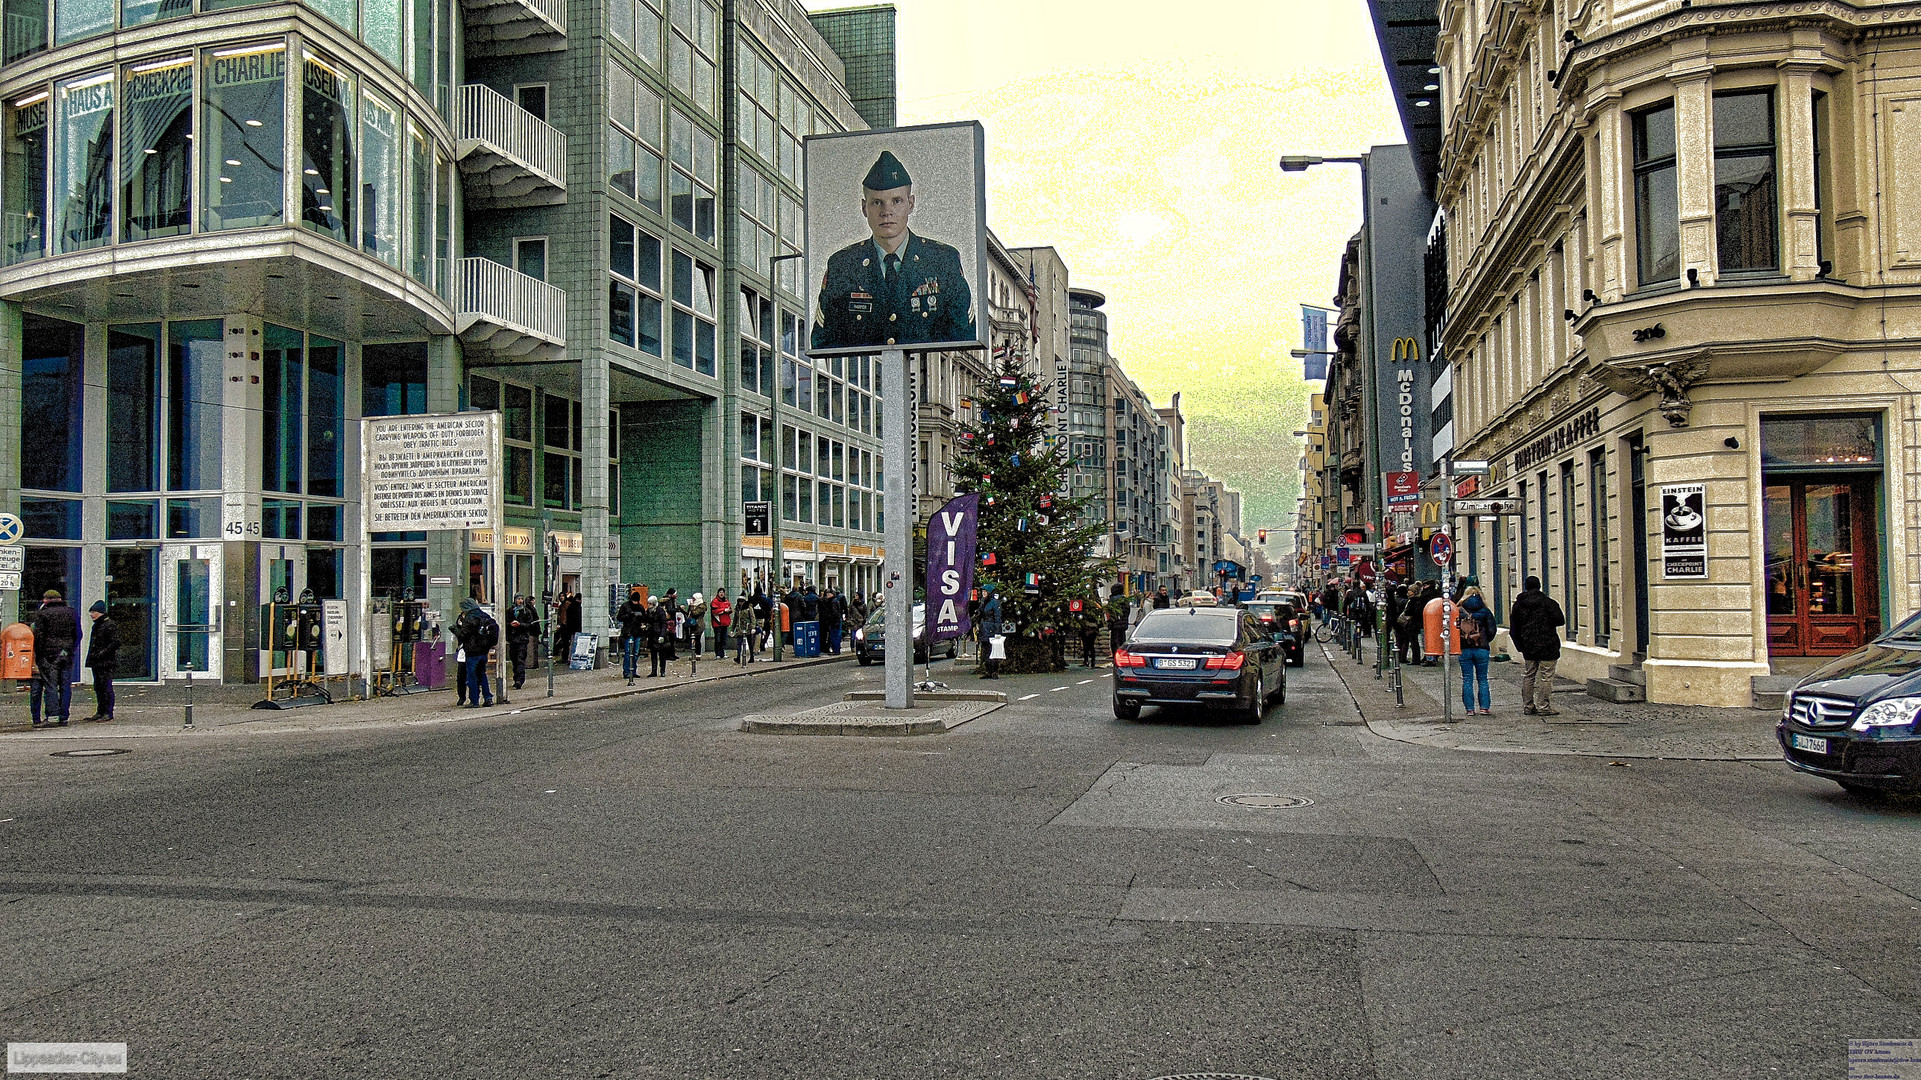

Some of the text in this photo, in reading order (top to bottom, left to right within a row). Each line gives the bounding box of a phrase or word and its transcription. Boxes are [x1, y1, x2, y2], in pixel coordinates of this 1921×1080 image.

[214, 50, 285, 85] CHARLIE
[70, 83, 102, 115] HAUS
[17, 101, 48, 132] MUSE
[1057, 365, 1068, 413] CHARLIE
[400, 423, 424, 431] ENTERING
[437, 421, 463, 429] AMERICAN
[465, 420, 484, 428] SECTOR
[1397, 369, 1414, 473] McDonalds
[1558, 406, 1599, 450] KAFFEE
[376, 433, 400, 441] CARRYING
[403, 431, 427, 439] WEAPONS
[441, 430, 453, 438] DUTY
[456, 428, 485, 437] FORBIDDEN
[442, 438, 458, 446] RULES
[465, 449, 484, 457] СЕКТОР
[435, 480, 457, 488] SECTEUR
[398, 491, 414, 499] PORTER
[424, 490, 437, 498] ARMES
[471, 488, 488, 496] SERVICE
[1662, 486, 1703, 495] EINSTEIN
[450, 497, 482, 505] CIRCULATION
[374, 509, 488, 521] SIE BETRETEN DEN AMERIKANISCHEN SEKTOR
[225, 521, 260, 535] 45 45
[1666, 536, 1703, 544] KAFFEE
[937, 511, 965, 625] VISA
[1666, 566, 1703, 574] CHARLIE
[937, 625, 959, 633] STAMP
[1809, 739, 1825, 752] 7668
